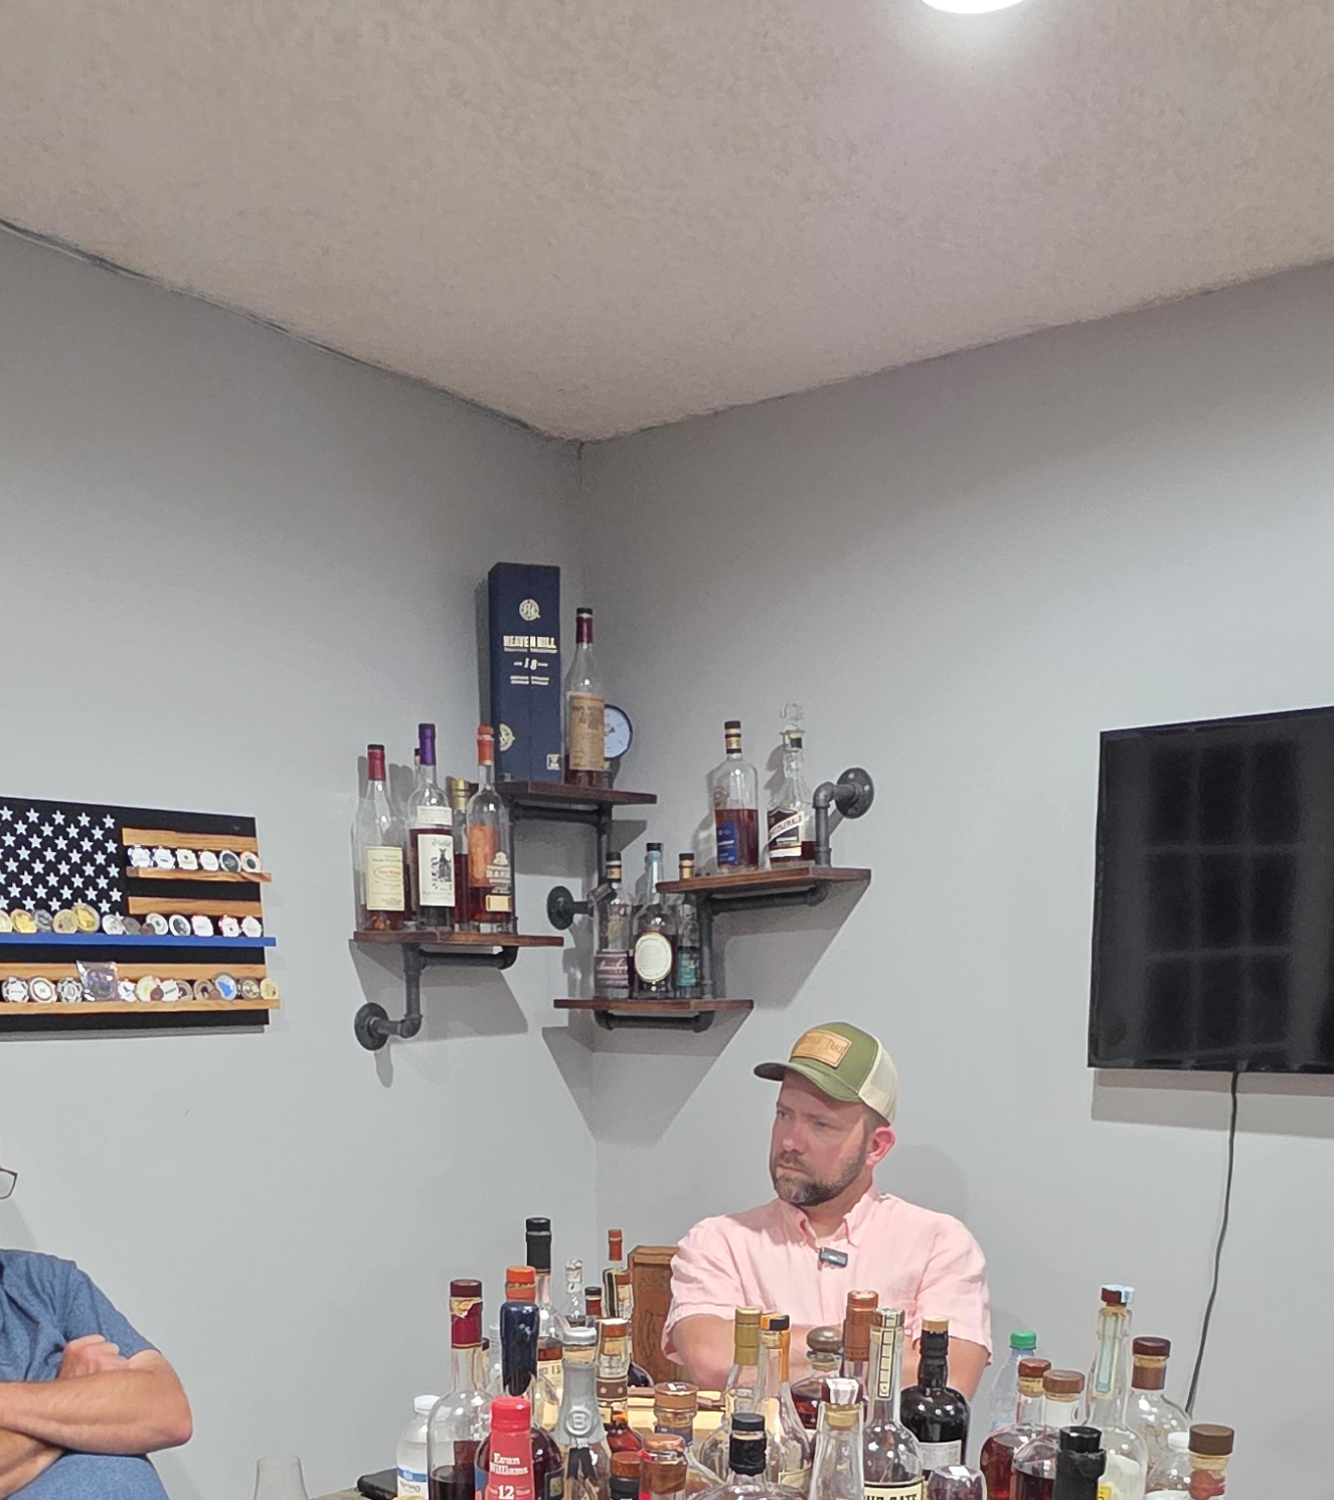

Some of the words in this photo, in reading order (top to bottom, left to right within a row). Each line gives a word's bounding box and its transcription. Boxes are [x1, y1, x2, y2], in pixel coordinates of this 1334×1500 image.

[524, 657, 538, 670] 18
[493, 1453, 520, 1465] Evan
[498, 1485, 514, 1500] 12
